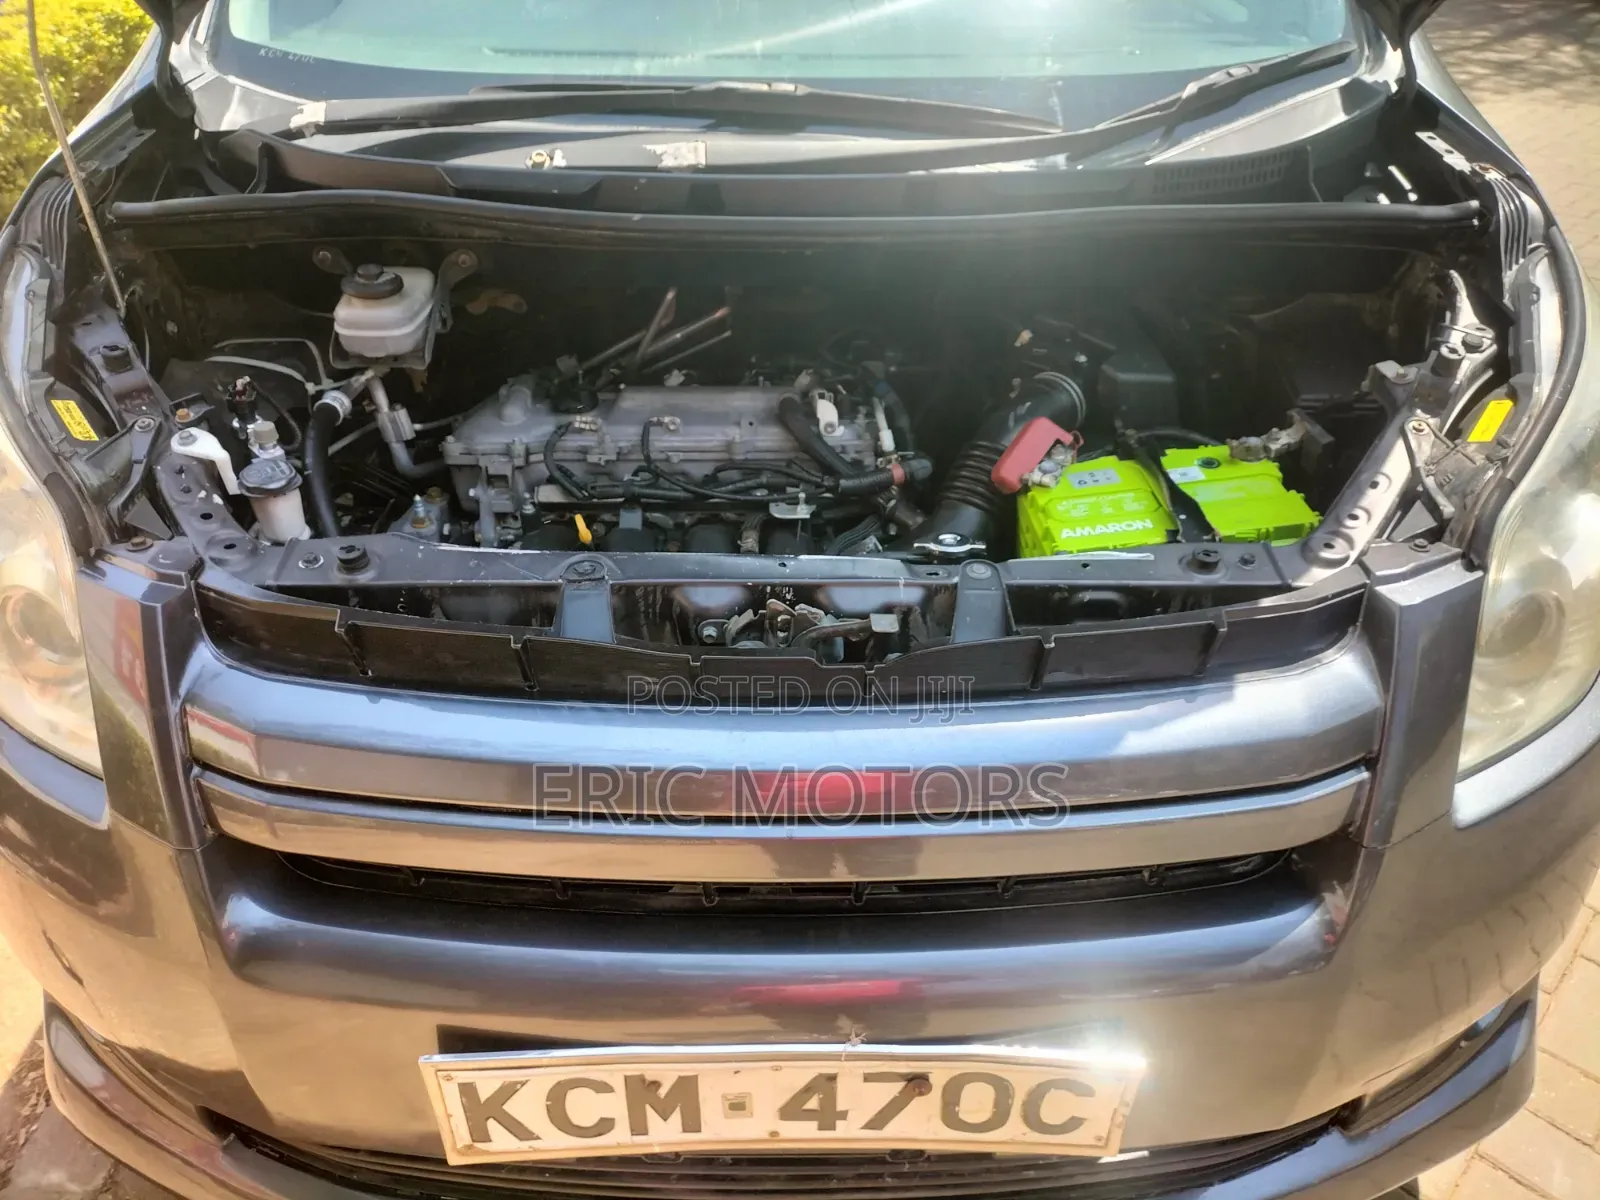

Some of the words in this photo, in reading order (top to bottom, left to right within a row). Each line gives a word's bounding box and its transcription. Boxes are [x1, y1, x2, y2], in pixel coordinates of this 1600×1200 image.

[1061, 518, 1154, 539] AMARON
[457, 1074, 703, 1144] KCM
[778, 1072, 1096, 1136] 470C
